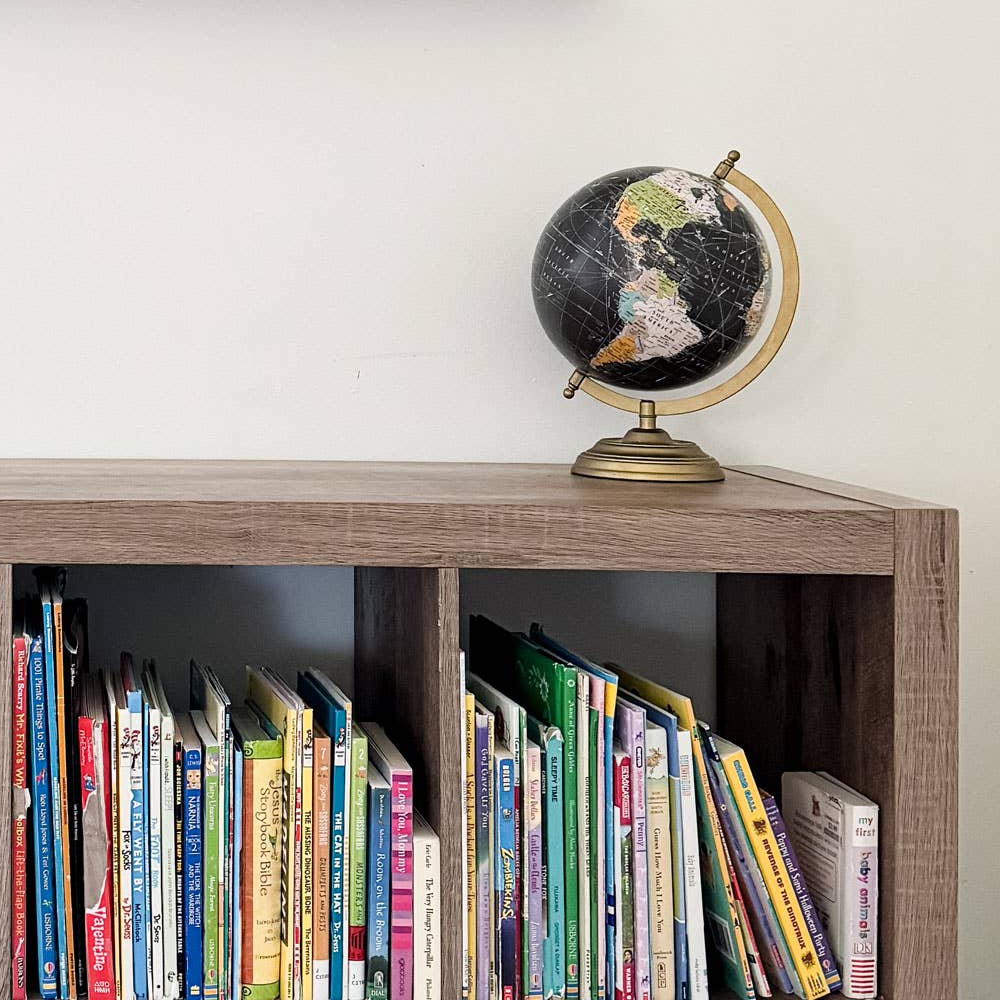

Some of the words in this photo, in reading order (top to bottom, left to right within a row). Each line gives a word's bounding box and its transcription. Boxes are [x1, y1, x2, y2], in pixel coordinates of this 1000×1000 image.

[16, 650, 25, 681] Richard
[16, 683, 24, 711] Scarry
[35, 677, 43, 701] Pirate
[16, 714, 24, 730] Mr.
[34, 703, 45, 730] Things
[16, 733, 25, 764] Fixit's
[36, 742, 46, 761] Spot
[320, 747, 327, 760] 7
[358, 748, 365, 760] 2
[480, 770, 489, 793] Gave
[502, 765, 511, 791] BOLGER
[550, 756, 558, 783] SLEEPY
[134, 799, 143, 809] A
[268, 780, 282, 825] Jesus
[398, 786, 407, 810] Love
[550, 785, 558, 802] TIME
[134, 813, 143, 832] FLY
[187, 795, 196, 830] NARNIA
[255, 787, 271, 859] Storybook
[334, 811, 342, 830] THE
[481, 814, 489, 828] You
[858, 817, 873, 826] my
[122, 830, 132, 843] Fox
[334, 834, 342, 853] CAT
[636, 822, 645, 846] Penny
[856, 827, 876, 837] first
[122, 849, 133, 870] Socks
[134, 838, 143, 871] WENT
[334, 857, 342, 867] IN
[395, 833, 407, 873] Mommy
[653, 851, 661, 869] How
[762, 839, 781, 875] REVENGE
[259, 861, 271, 897] Bible
[377, 853, 386, 881] Room
[857, 850, 872, 884] baby
[134, 879, 143, 893] BY
[334, 871, 342, 889] THE
[355, 861, 364, 907] MONSTERS
[377, 885, 385, 897] on
[426, 878, 434, 891] The
[501, 847, 515, 919] ZOMBIEKINS
[777, 878, 785, 888] OF
[334, 892, 342, 914] HAT
[376, 902, 386, 915] the
[424, 892, 434, 907] Very
[780, 890, 790, 906] THE
[785, 857, 794, 871] and
[799, 894, 817, 934] Halloween
[813, 933, 826, 955] Party
[15, 912, 24, 936] Book
[134, 903, 142, 943] McClintock
[319, 911, 327, 932] PESTS
[424, 908, 434, 933] Hungry
[858, 888, 871, 939] animals
[43, 912, 52, 952] USBORNE
[89, 906, 108, 972] Valentine
[376, 919, 386, 951] Broom
[568, 920, 577, 959] USBORNE
[787, 907, 806, 948] DINOTRUX
[333, 934, 341, 953] Seuss
[424, 933, 434, 968] Caterpillar
